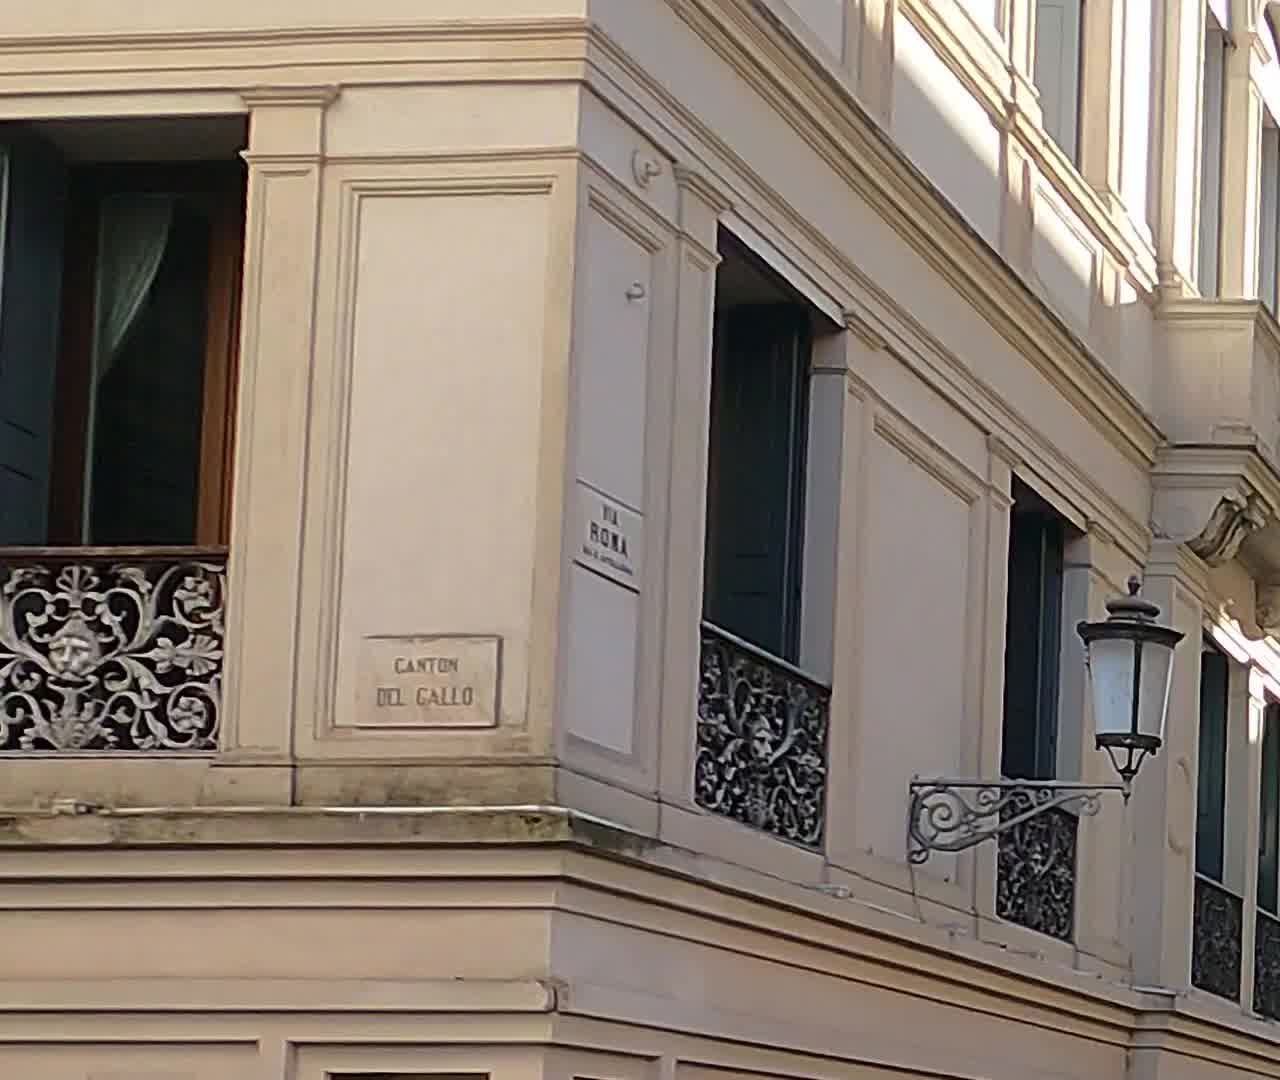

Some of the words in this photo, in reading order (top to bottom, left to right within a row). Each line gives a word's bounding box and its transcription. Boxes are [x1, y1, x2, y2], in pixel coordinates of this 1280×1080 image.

[589, 519, 629, 559] ROMA
[395, 657, 458, 673] CANTON
[377, 687, 408, 707] DEL
[416, 687, 474, 707] GALLO
